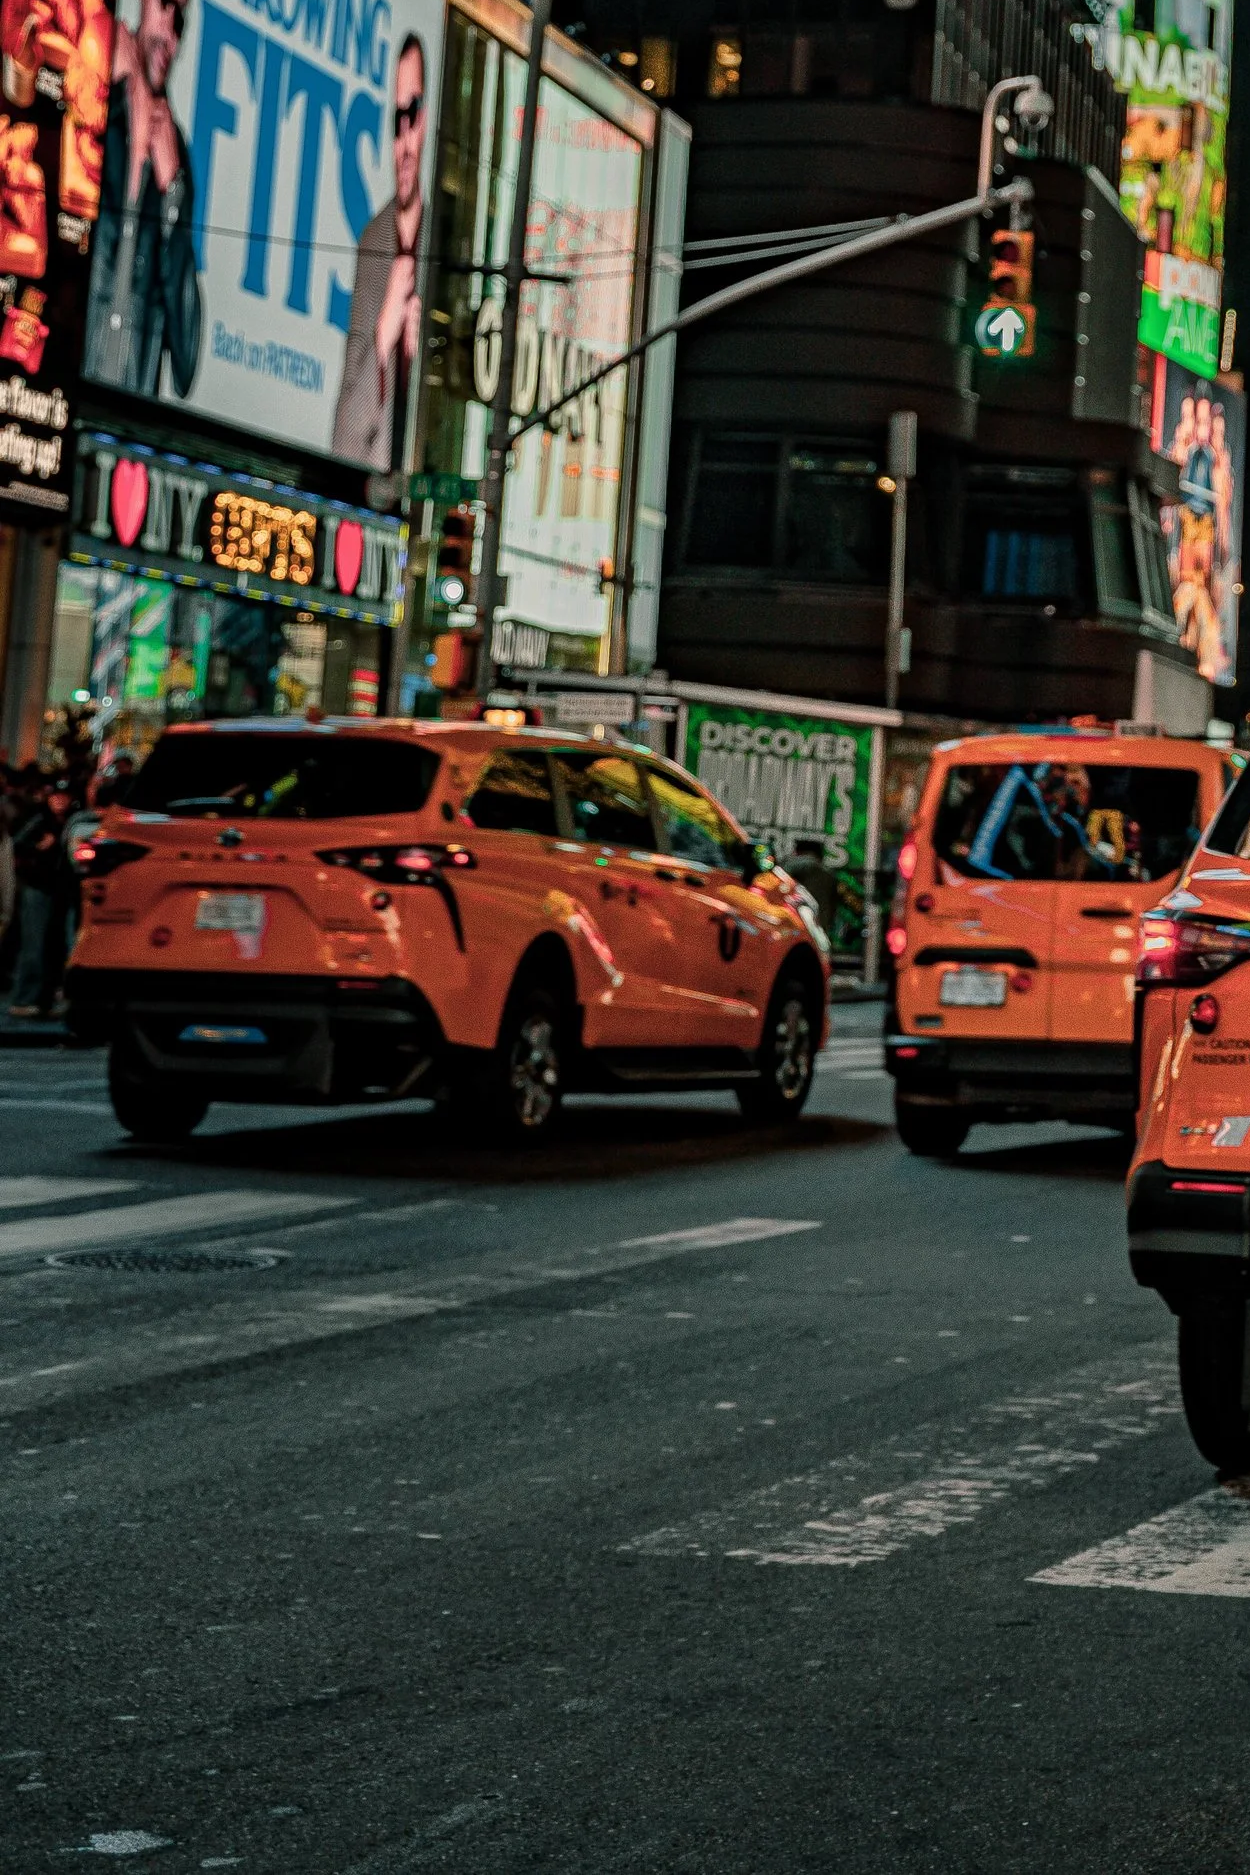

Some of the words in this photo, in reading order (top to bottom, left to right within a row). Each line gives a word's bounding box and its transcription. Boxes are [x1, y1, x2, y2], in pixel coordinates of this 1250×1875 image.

[91, 452, 117, 538] I
[141, 468, 208, 561] NY
[211, 490, 317, 586] GIFTS
[700, 720, 857, 763] DISCOVER
[1192, 1053, 1246, 1065] PASSENGER
